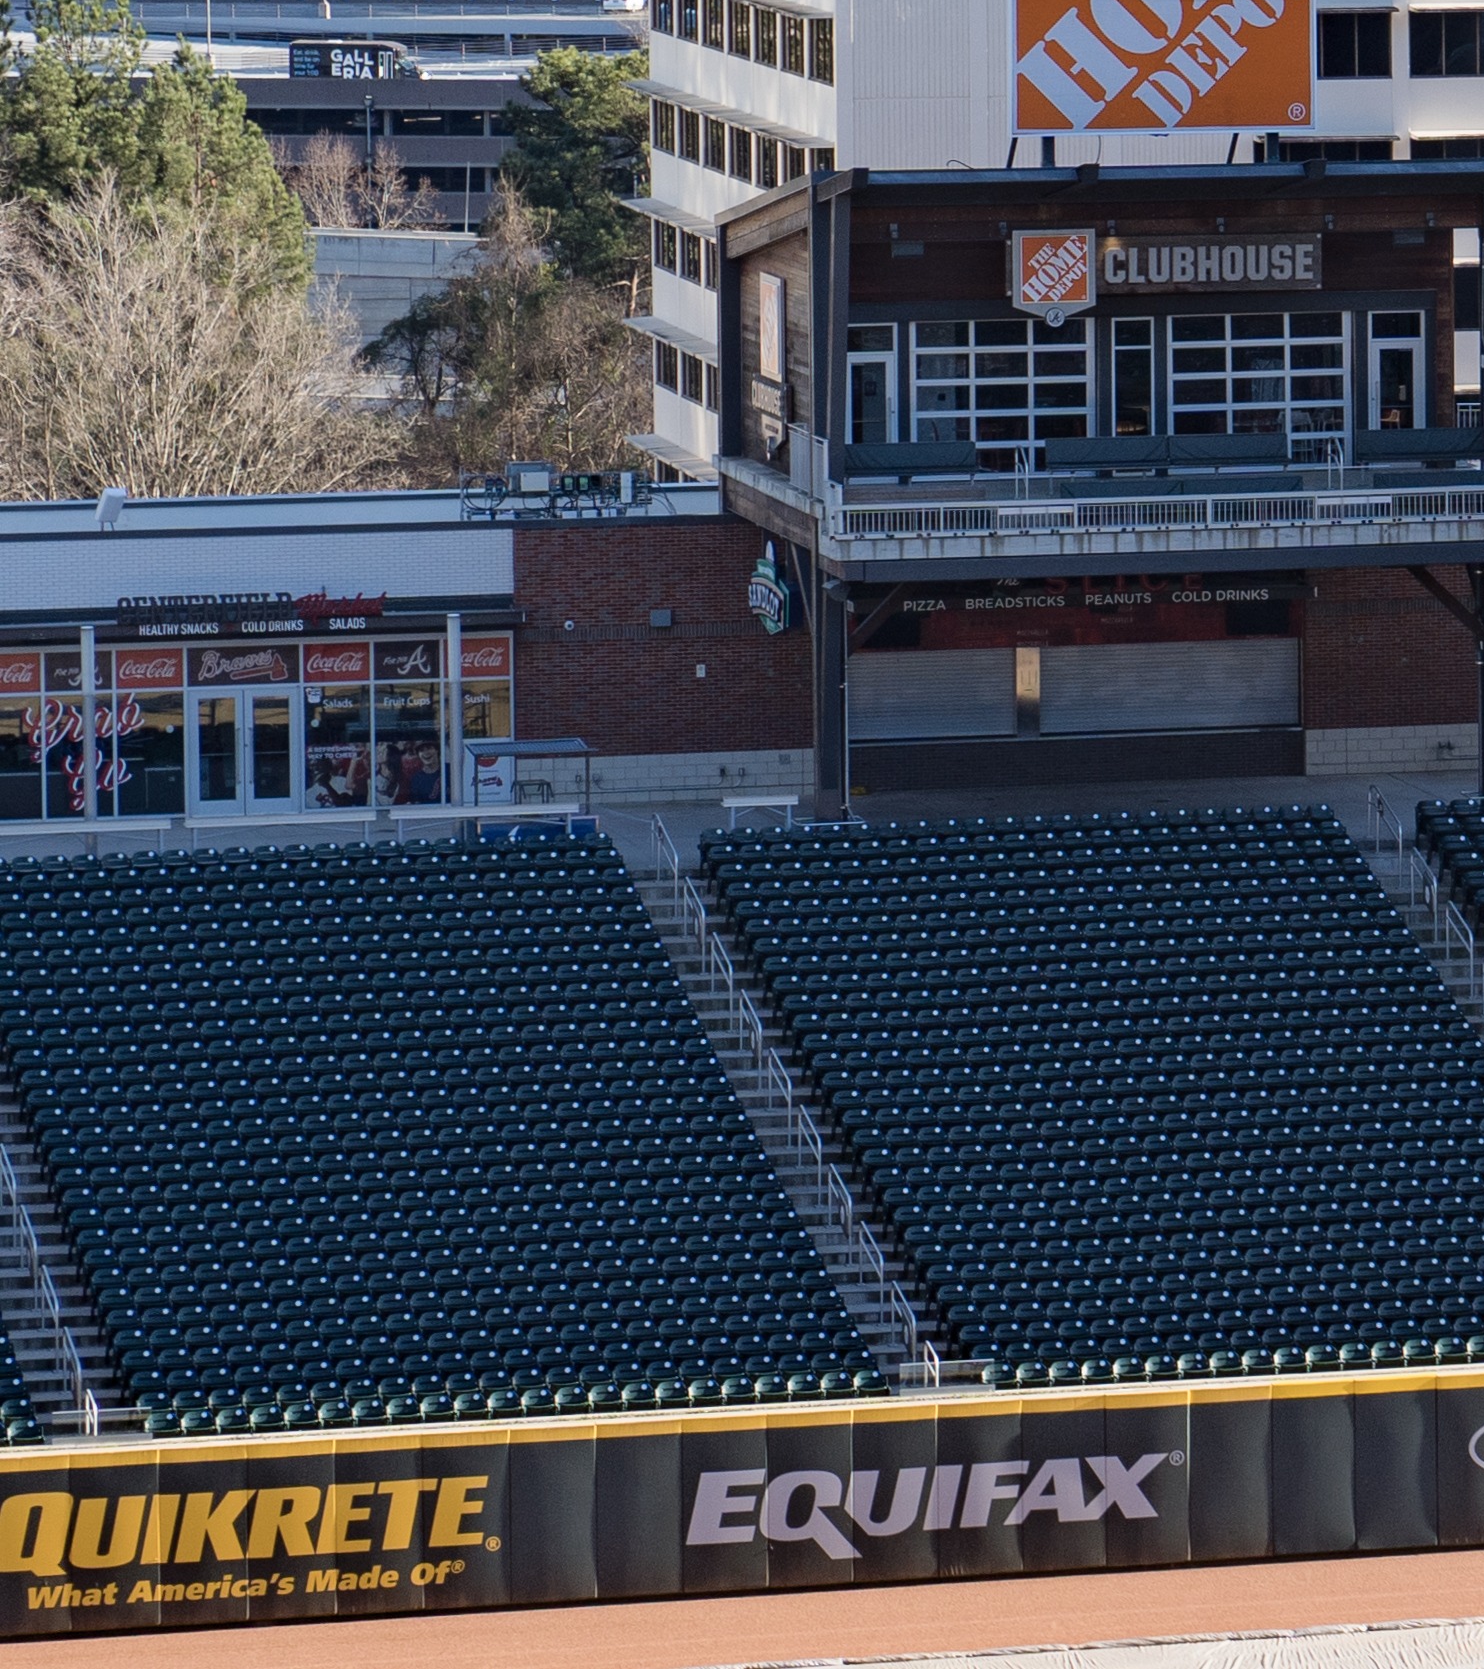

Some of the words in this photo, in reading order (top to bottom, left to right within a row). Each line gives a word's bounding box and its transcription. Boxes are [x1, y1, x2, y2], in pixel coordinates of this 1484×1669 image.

[1021, 235, 1088, 303] HOME
[1028, 242, 1056, 272] THE
[1104, 244, 1315, 283] CLUBHOUSE
[1047, 259, 1089, 302] DEPOT
[903, 600, 947, 612] PIZZA
[965, 595, 1066, 610] BREADSTICKS
[1085, 592, 1152, 606] PEANUTS
[1171, 589, 1212, 603] COLD
[1216, 588, 1270, 602] DRINKS
[139, 624, 179, 636] HEALTHY
[181, 623, 219, 635] SNACKS
[241, 621, 267, 633] COLD
[269, 619, 304, 632] DRINKS
[329, 618, 366, 630] SALADS
[198, 649, 275, 681] Braves
[323, 698, 353, 708] Salads
[383, 697, 405, 707] Fruit
[407, 696, 431, 708] Cups
[464, 693, 490, 704] Sushi
[27, 1573, 118, 1611] What
[127, 1569, 294, 1605] America's
[306, 1563, 399, 1594] Made
